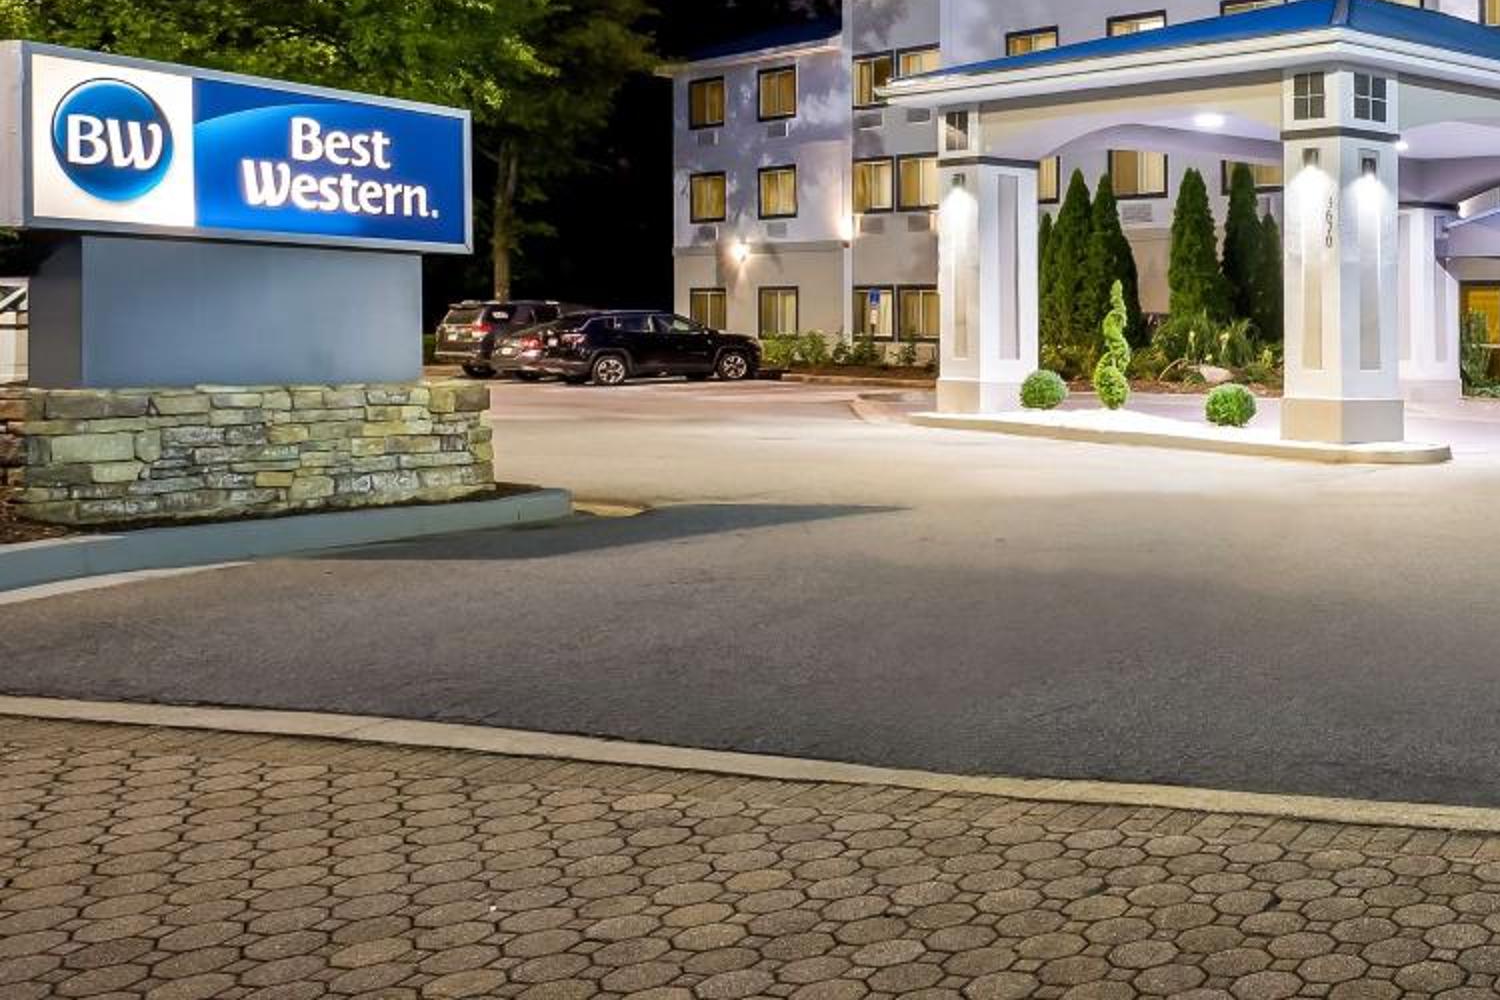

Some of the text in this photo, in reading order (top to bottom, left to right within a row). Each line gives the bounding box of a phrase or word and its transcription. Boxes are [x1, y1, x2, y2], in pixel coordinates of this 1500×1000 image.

[66, 113, 164, 171] BW
[289, 116, 392, 170] Best
[241, 158, 440, 219] Western.
